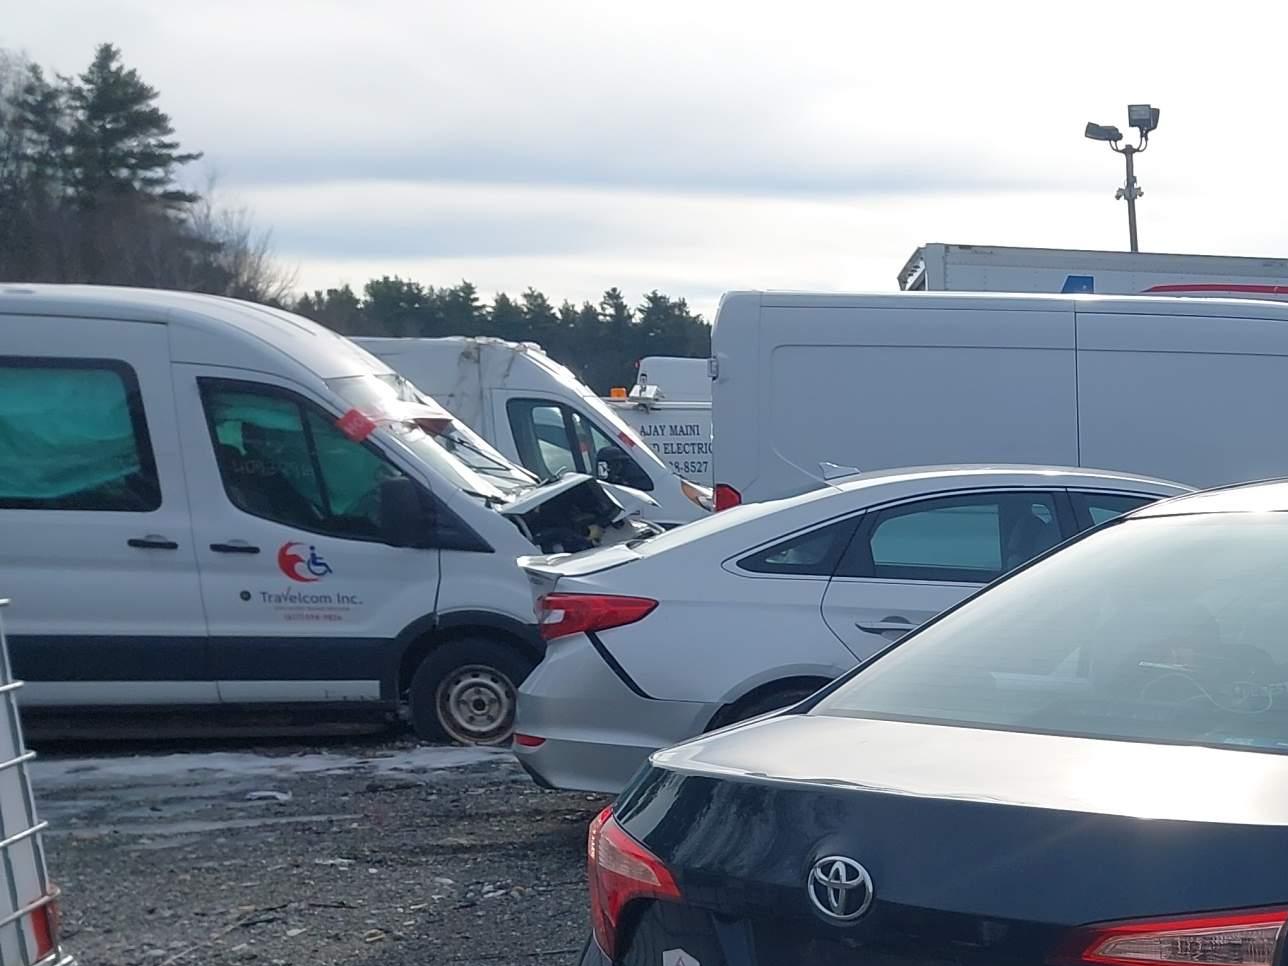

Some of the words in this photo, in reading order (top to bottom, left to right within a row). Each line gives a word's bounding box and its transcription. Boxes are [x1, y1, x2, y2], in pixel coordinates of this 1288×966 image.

[640, 424, 666, 436] AJAY
[669, 424, 700, 436] MAINI
[260, 586, 332, 605] Travelcom
[337, 592, 364, 605] Inc.
